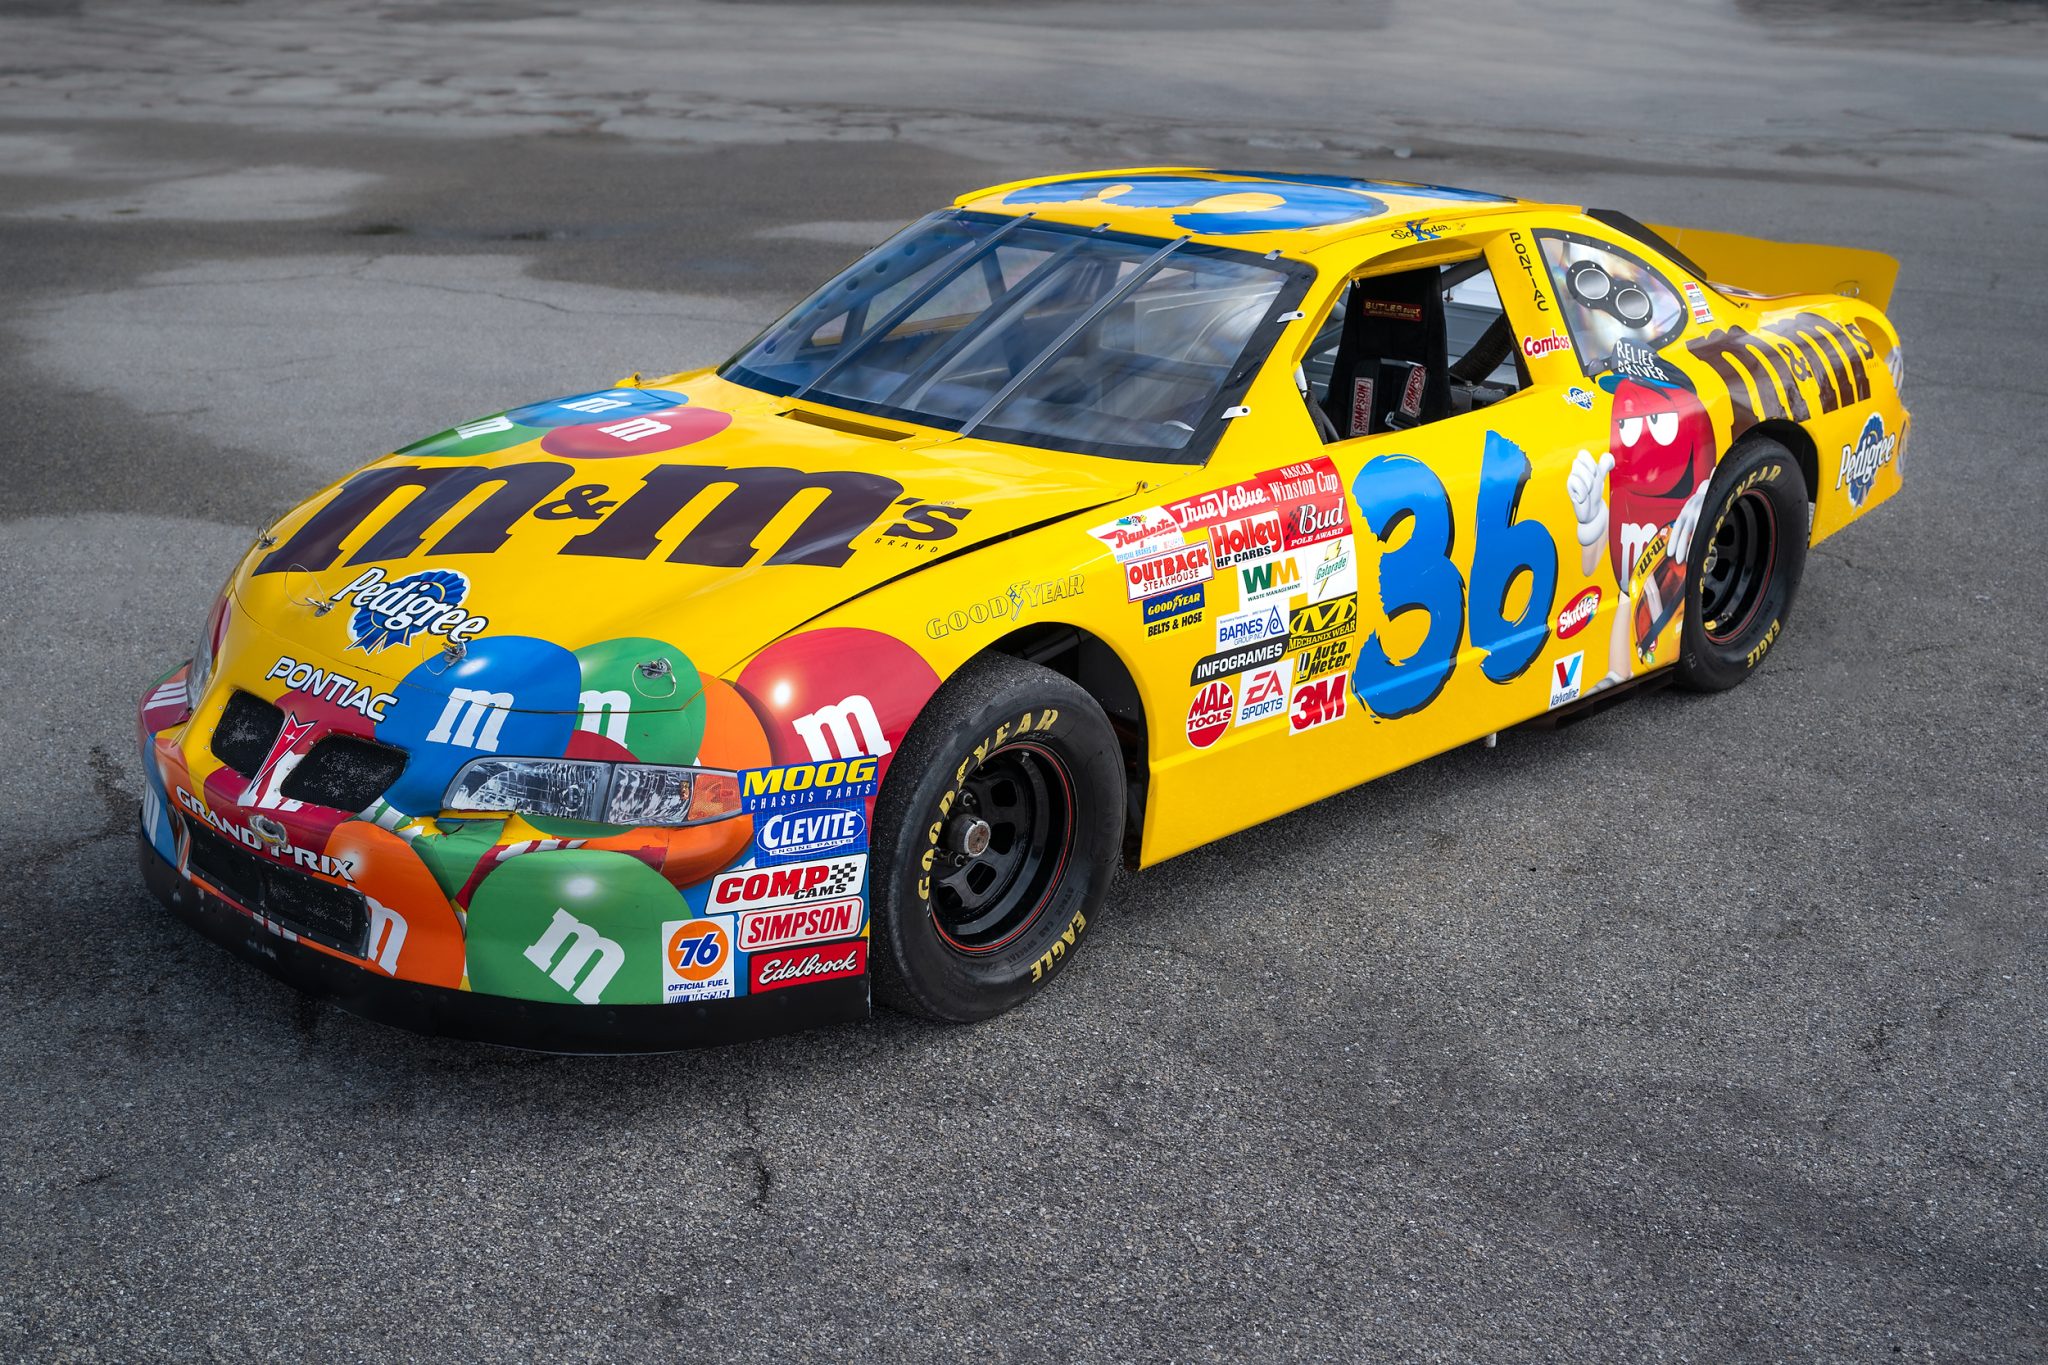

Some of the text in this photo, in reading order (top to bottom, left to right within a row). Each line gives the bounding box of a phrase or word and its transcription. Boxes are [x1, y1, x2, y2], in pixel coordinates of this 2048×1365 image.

[1509, 232, 1549, 312] PONTIAC
[1523, 330, 1570, 356] Combos
[1616, 340, 1655, 367] RELIEF
[1618, 360, 1669, 381] DRIVER
[1353, 384, 1367, 430] SIMPSON
[597, 417, 672, 442] m
[1280, 462, 1314, 480] NASCAR
[1835, 432, 1895, 490] Pedigree
[1268, 471, 1339, 503] Winston Cup
[252, 461, 972, 577] m&m's
[1299, 498, 1345, 534] Bud
[874, 538, 938, 553] BRAND
[1210, 518, 1282, 557] Holley
[1290, 527, 1344, 547] POLE AWARD
[1129, 547, 1211, 584] OUTBACK
[1216, 546, 1272, 568] HP CARBS
[1242, 556, 1300, 594] WM
[1315, 556, 1348, 580] Gatorade
[1143, 568, 1200, 592] STEAKHOUSE
[1247, 583, 1301, 602] WASTE MANAGEMENT
[1352, 430, 1558, 721] 36
[332, 566, 490, 643] Pedigree
[1147, 592, 1201, 615] GOODYEAR
[1559, 594, 1599, 633] Skittles
[1147, 622, 1170, 637] BELTS
[1171, 619, 1179, 630] &
[1181, 612, 1203, 627] HOSE
[1220, 618, 1263, 642] BARNES
[1288, 620, 1356, 650] MECHANIX WEAR
[1196, 642, 1283, 679] INFOGRAMES
[1312, 641, 1347, 662] Auto
[1746, 618, 1781, 668] EAGLE
[1306, 653, 1351, 679] Meter
[265, 655, 399, 722] PONTIAC
[1188, 683, 1233, 719] MAC
[1243, 670, 1284, 706] EA
[1290, 674, 1347, 731] 3M
[1551, 688, 1579, 707] Valvoline
[426, 687, 515, 752] m
[1187, 709, 1232, 729] TOOLS
[1241, 698, 1283, 720] SPORTS
[792, 695, 892, 762] m
[743, 757, 879, 797] MOOG
[750, 783, 872, 811] CHASSIS PARTS
[176, 786, 262, 850] GRAND
[763, 811, 857, 849] CLEVITE
[271, 845, 356, 884] PRIX
[771, 838, 853, 855] ENGINE PARTS
[715, 865, 830, 905] COMP
[793, 883, 847, 900] CAMS
[747, 903, 853, 944] SIMPSON
[524, 907, 625, 1005] m
[676, 931, 721, 970] 76
[1029, 909, 1087, 984] EAGLE
[668, 978, 729, 992] OFFICIAL FUEL
[758, 950, 857, 985] Edelbrock
